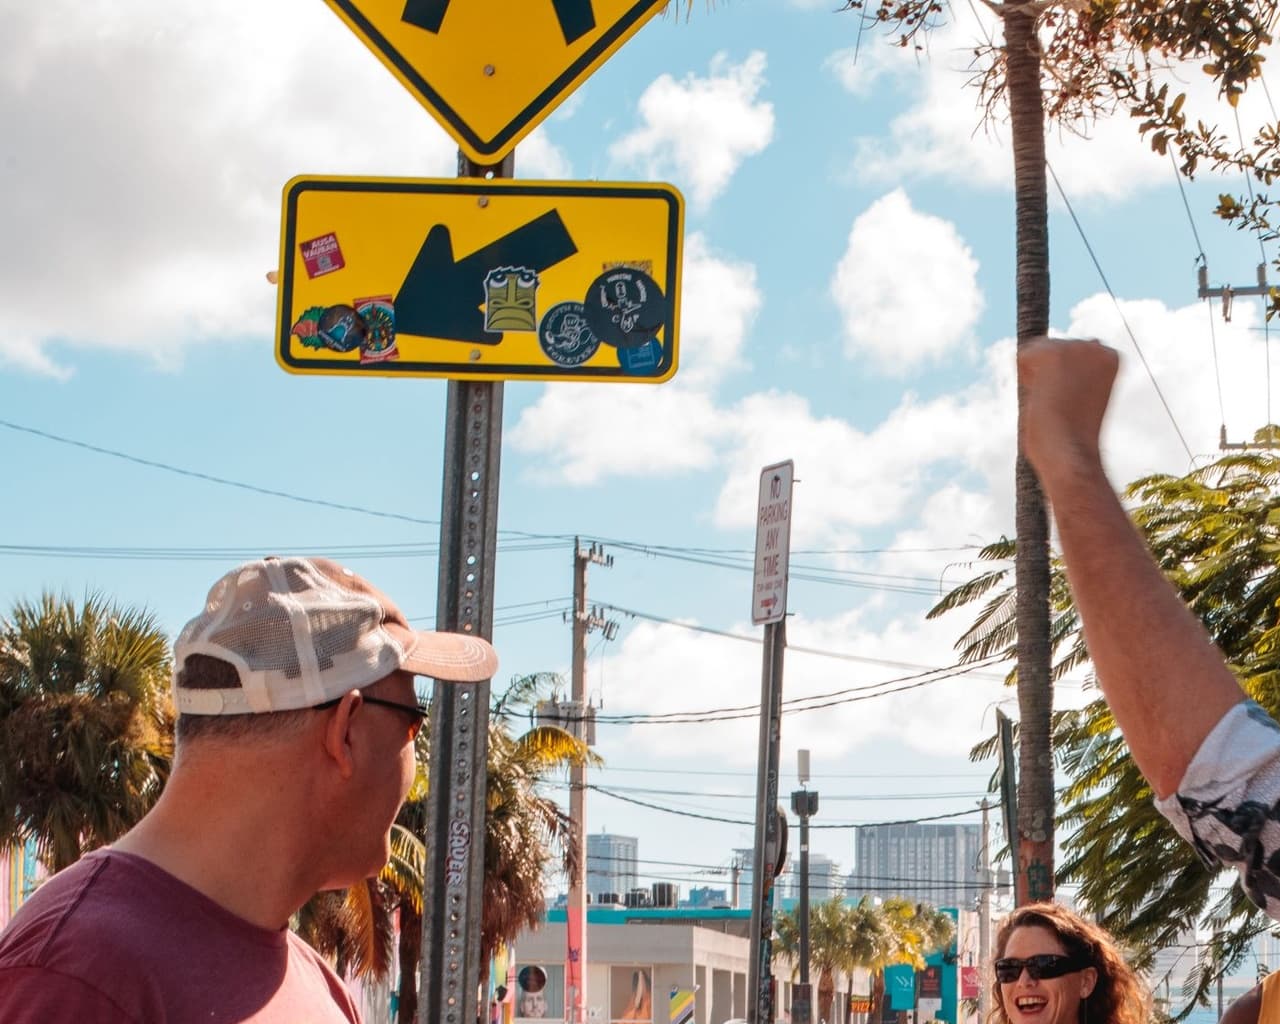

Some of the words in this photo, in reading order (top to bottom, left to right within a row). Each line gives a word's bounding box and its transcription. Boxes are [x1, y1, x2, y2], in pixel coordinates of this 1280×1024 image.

[770, 478, 782, 499] NO
[760, 501, 788, 527] PARKING
[765, 528, 780, 551] ANY
[763, 554, 780, 577] TIME
